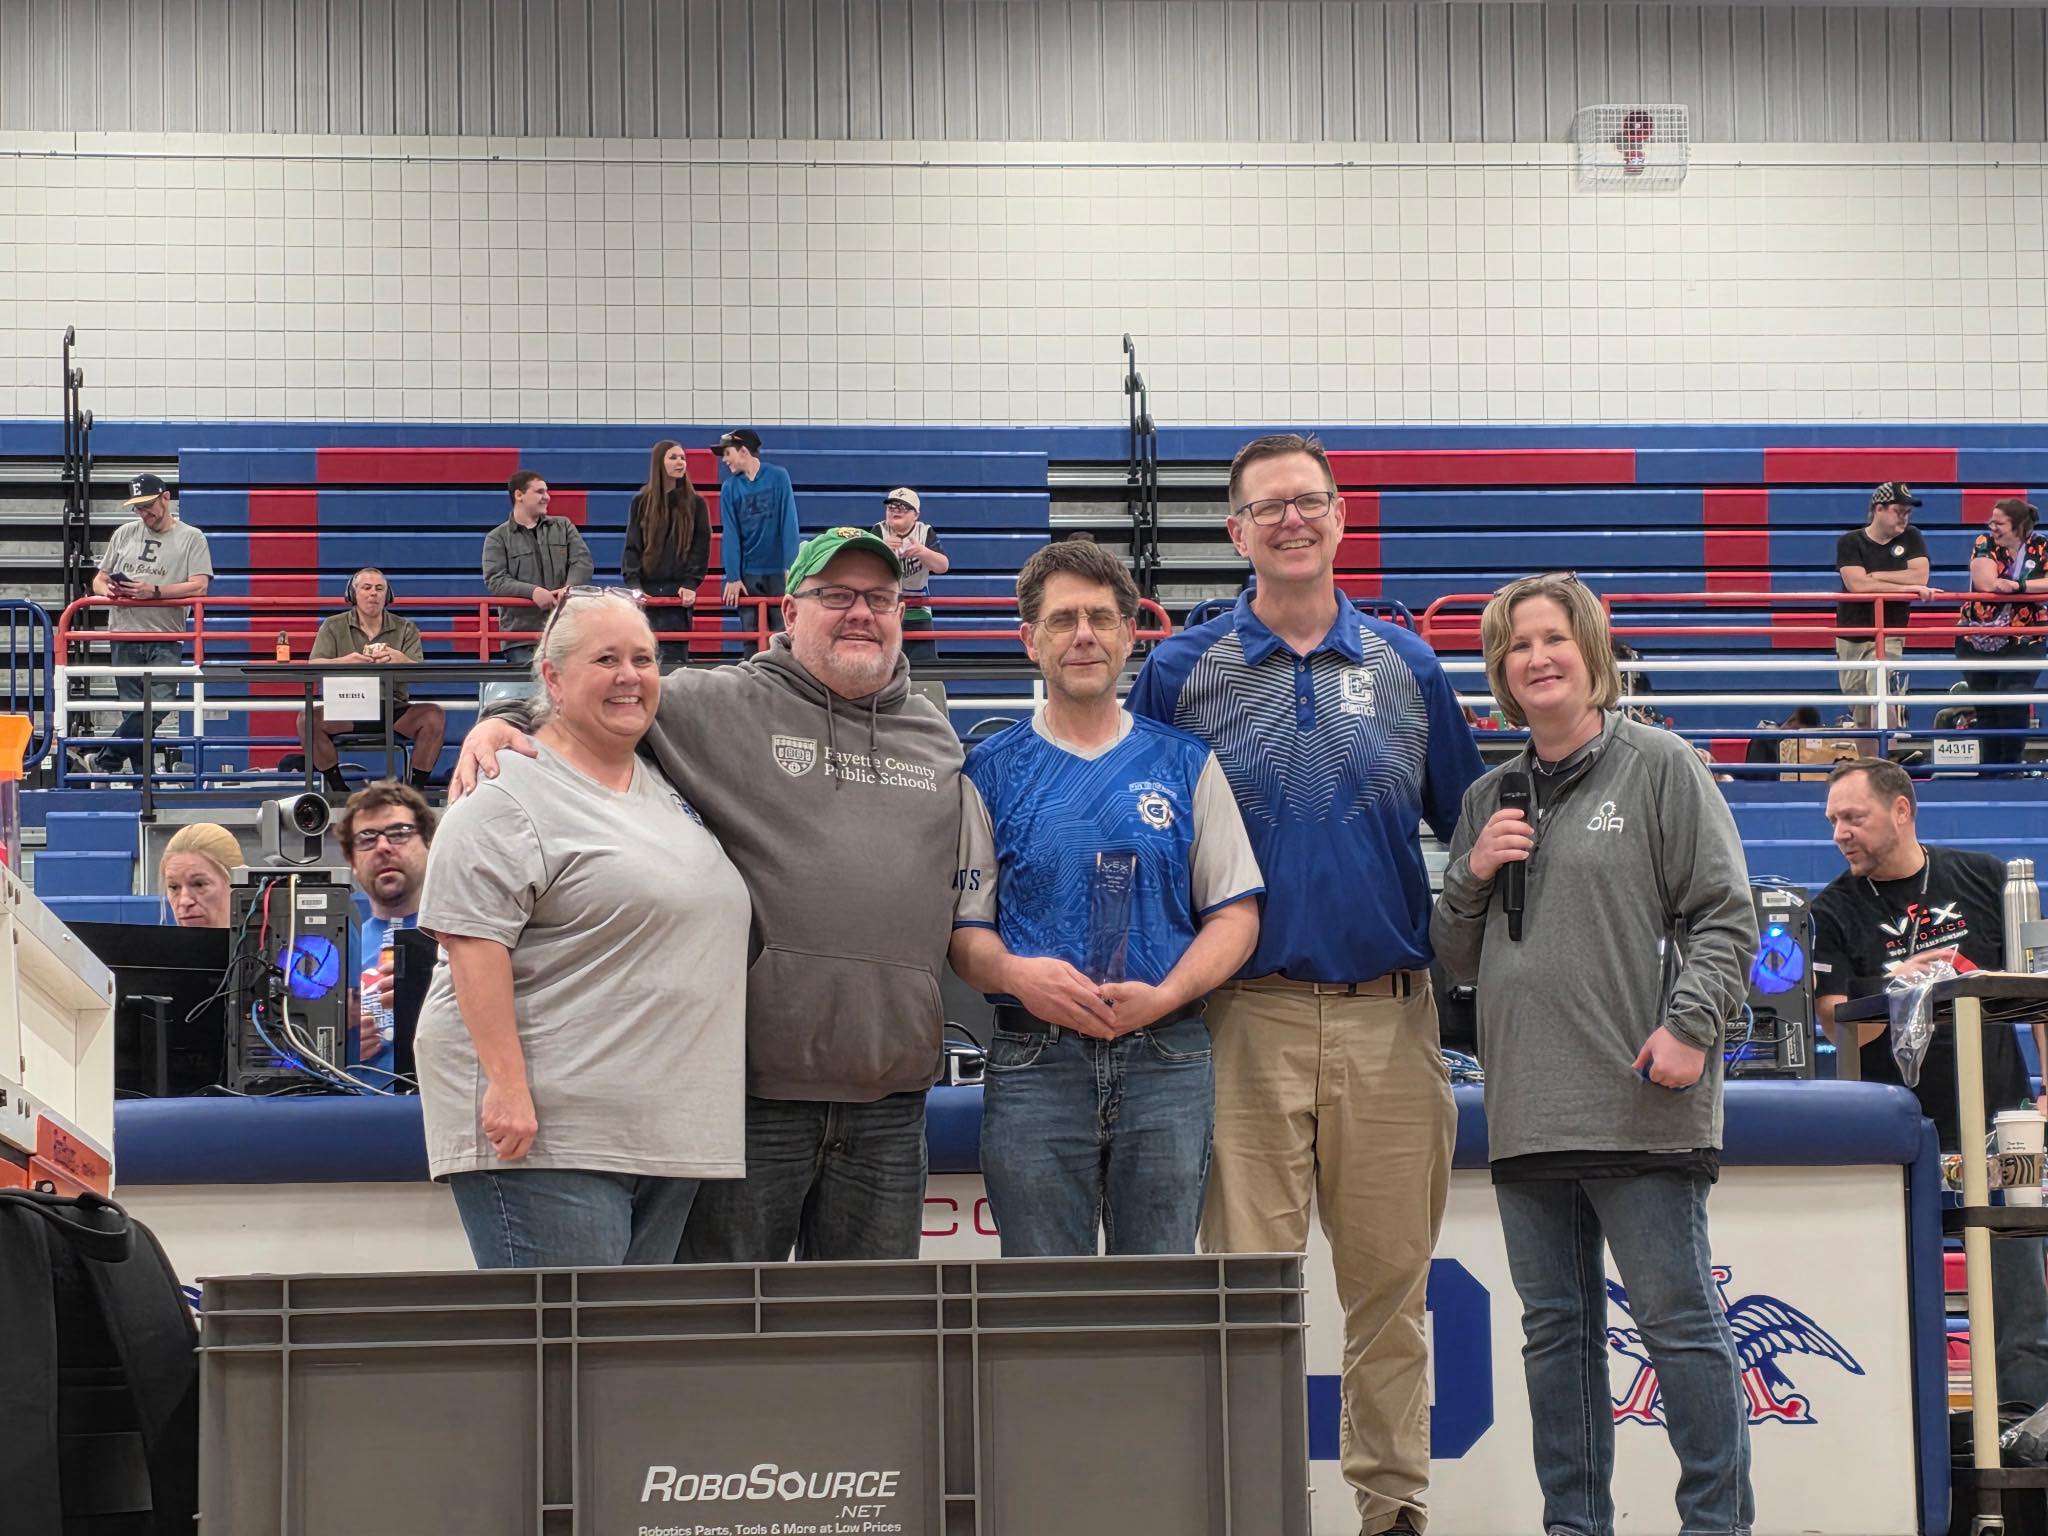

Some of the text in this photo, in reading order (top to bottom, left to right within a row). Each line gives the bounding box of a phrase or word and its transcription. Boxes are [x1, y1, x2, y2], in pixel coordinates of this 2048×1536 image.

[133, 483, 142, 496] E
[138, 540, 161, 562] E
[1938, 744, 1975, 754] 4431F
[824, 746, 935, 780] Fayette County
[824, 763, 937, 792] Public Schools
[1147, 803, 1164, 819] G
[835, 1505, 886, 1518] .NET
[638, 1521, 901, 1536] Robotics Parts, Tools & More at Low Prices
